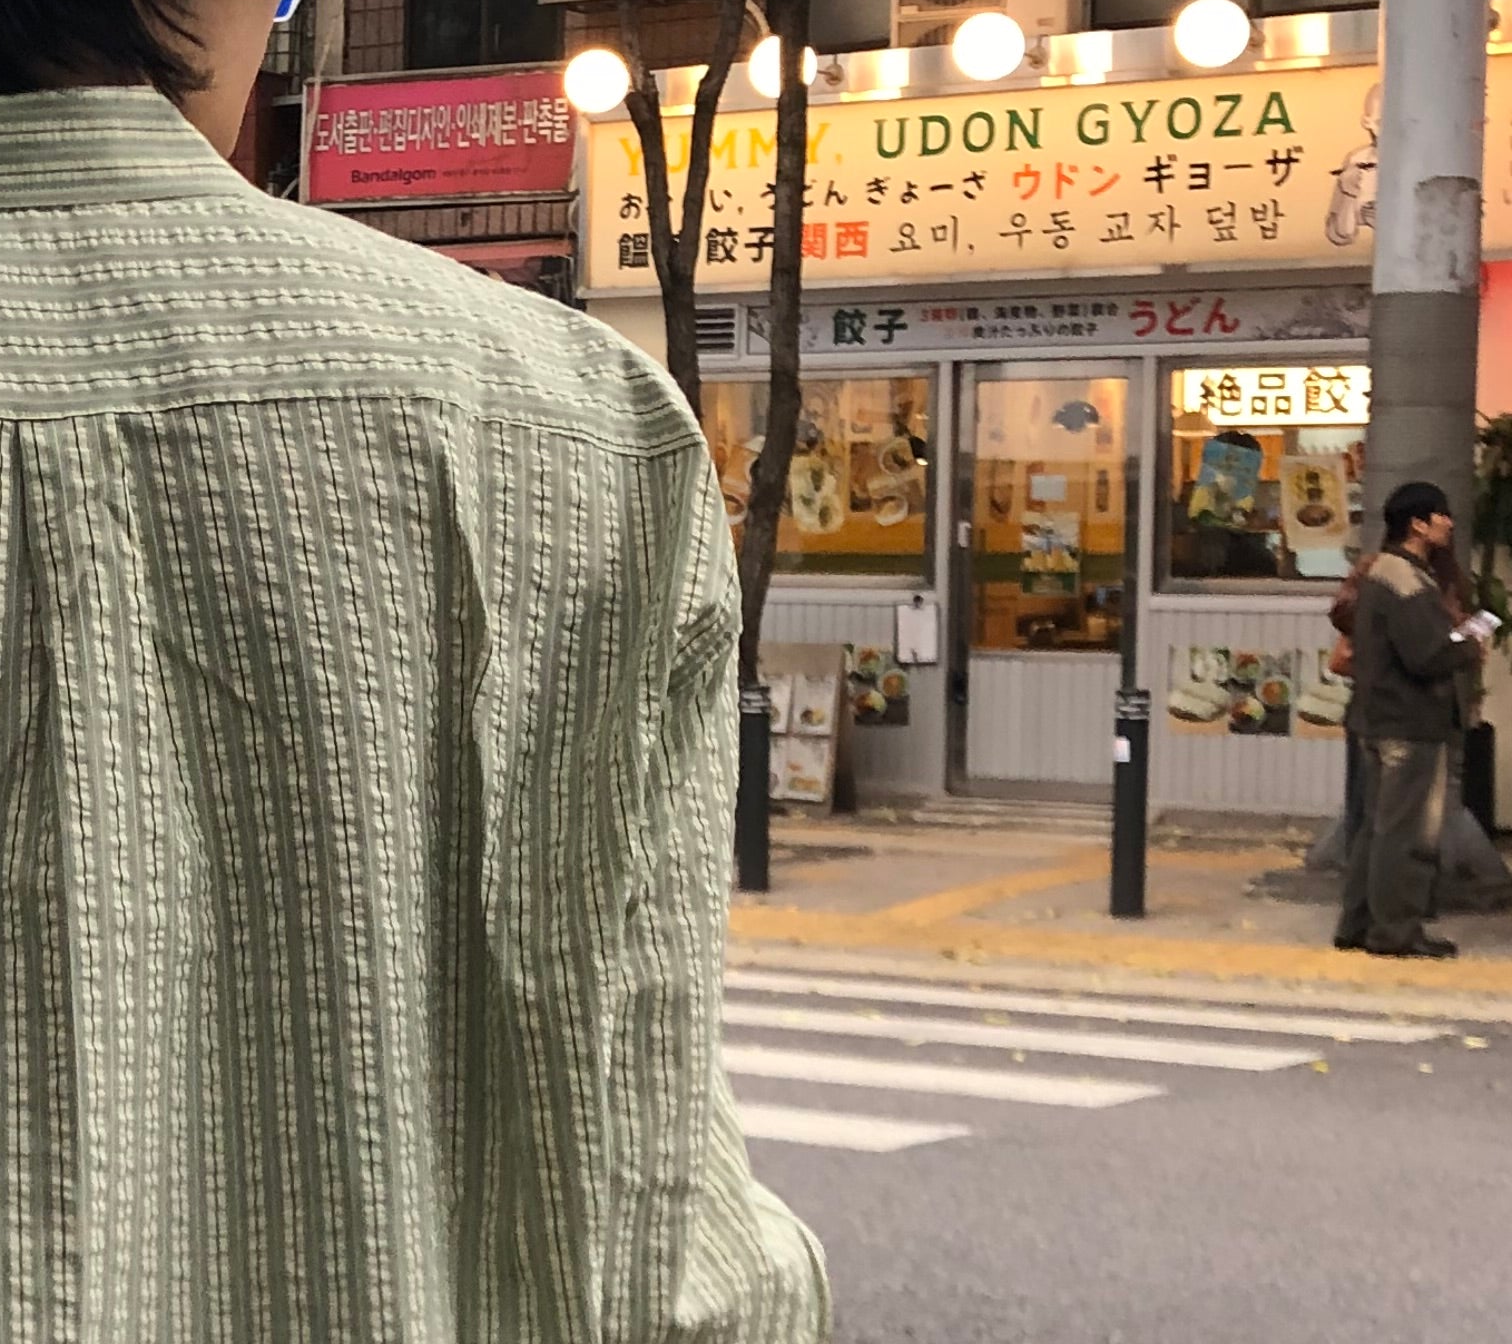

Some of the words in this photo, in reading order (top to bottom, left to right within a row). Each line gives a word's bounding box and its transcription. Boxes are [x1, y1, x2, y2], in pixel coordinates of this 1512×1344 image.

[874, 108, 1045, 159] UDON
[1076, 92, 1297, 146] GYOZA
[351, 168, 437, 185] Bandalgom
[1012, 160, 1122, 201] ウドン
[1143, 144, 1304, 194] ギョーザ
[999, 210, 1077, 250] 우동
[1099, 203, 1182, 244] 교자
[1206, 198, 1288, 242] 덮밥
[832, 308, 909, 346] 餃子
[1127, 297, 1241, 337] うどん
[1200, 368, 1373, 418] 絶品餃
